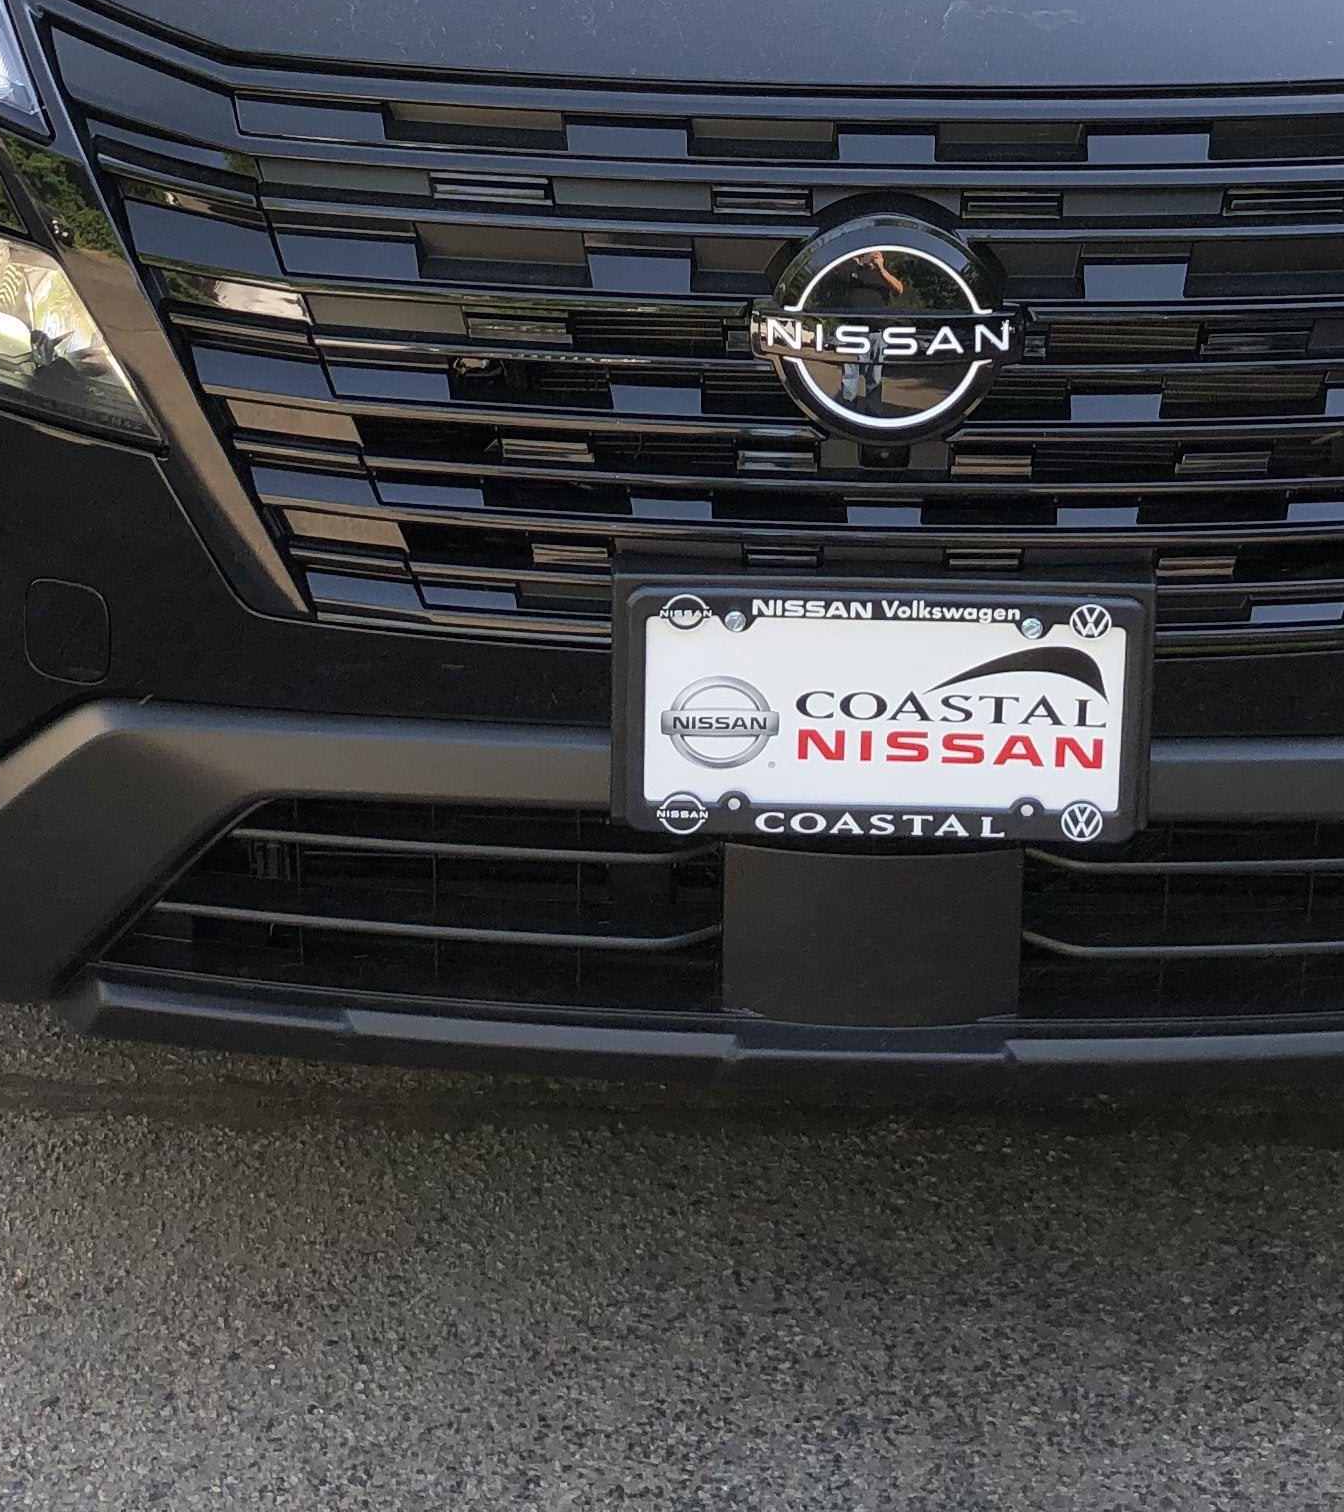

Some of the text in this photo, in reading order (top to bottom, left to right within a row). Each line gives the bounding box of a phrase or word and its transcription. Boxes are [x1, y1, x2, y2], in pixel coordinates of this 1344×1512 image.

[766, 318, 1010, 356] NISSAN
[659, 609, 713, 619] NISSAN
[751, 598, 1021, 624] NISSAN Volkswagen
[672, 714, 768, 732] NISSAN
[795, 690, 1108, 729] COASTAL
[796, 728, 1104, 770] NISSAN
[656, 809, 709, 821] NISSAN
[755, 811, 1006, 839] COASTAL
